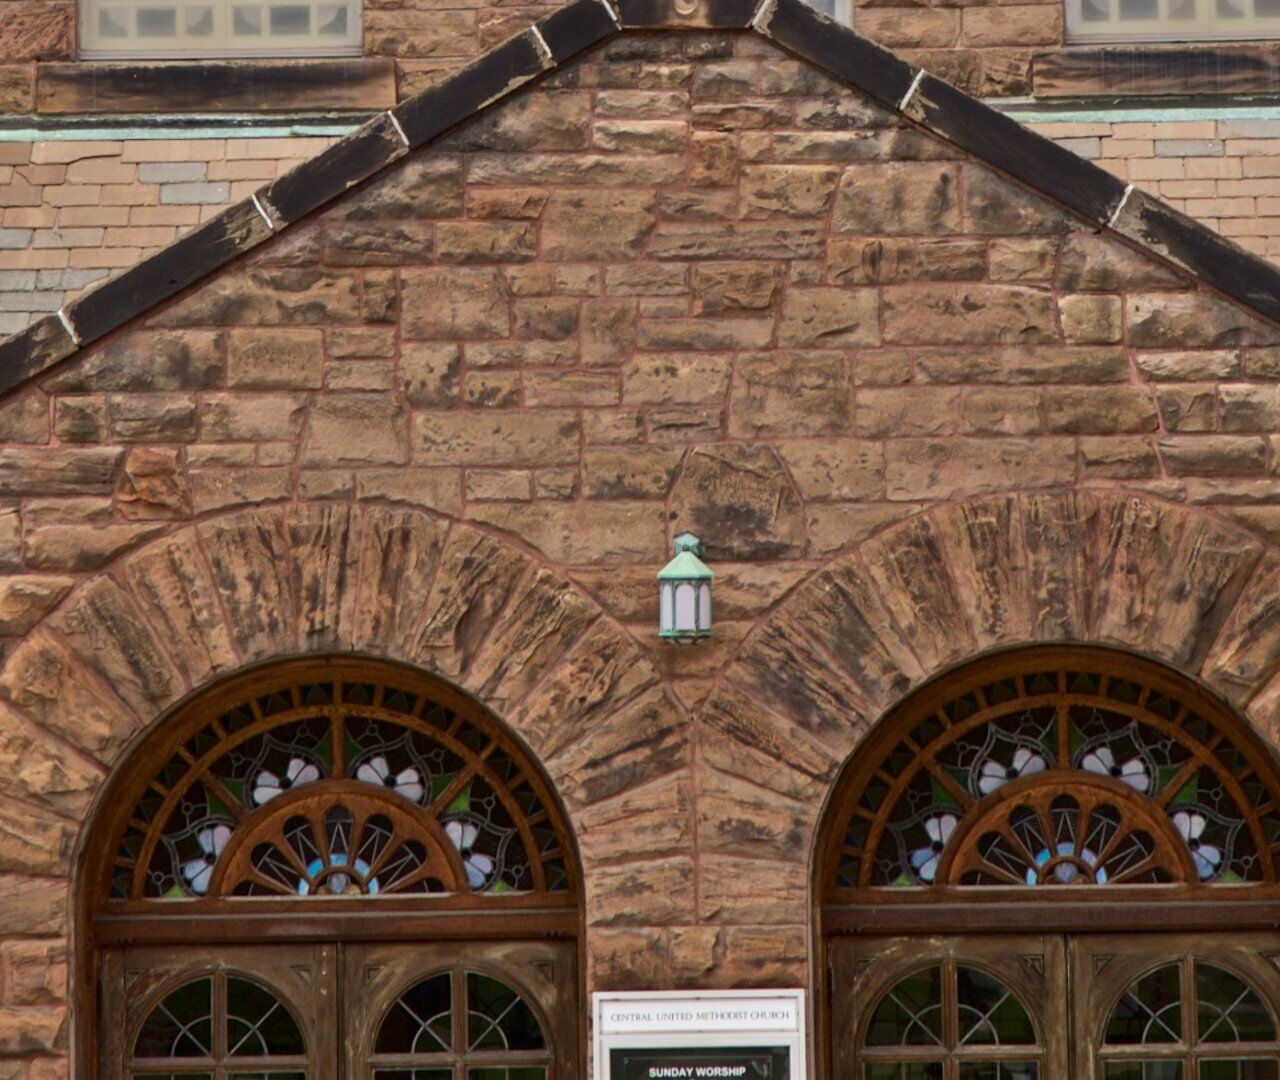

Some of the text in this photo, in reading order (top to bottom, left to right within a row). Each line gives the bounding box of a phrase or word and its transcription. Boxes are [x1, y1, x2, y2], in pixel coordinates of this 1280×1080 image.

[610, 1010, 789, 1022] CENTRAL UNITED METHODIST CHURCH
[648, 1066, 746, 1078] SUNDAY WORSHIP
